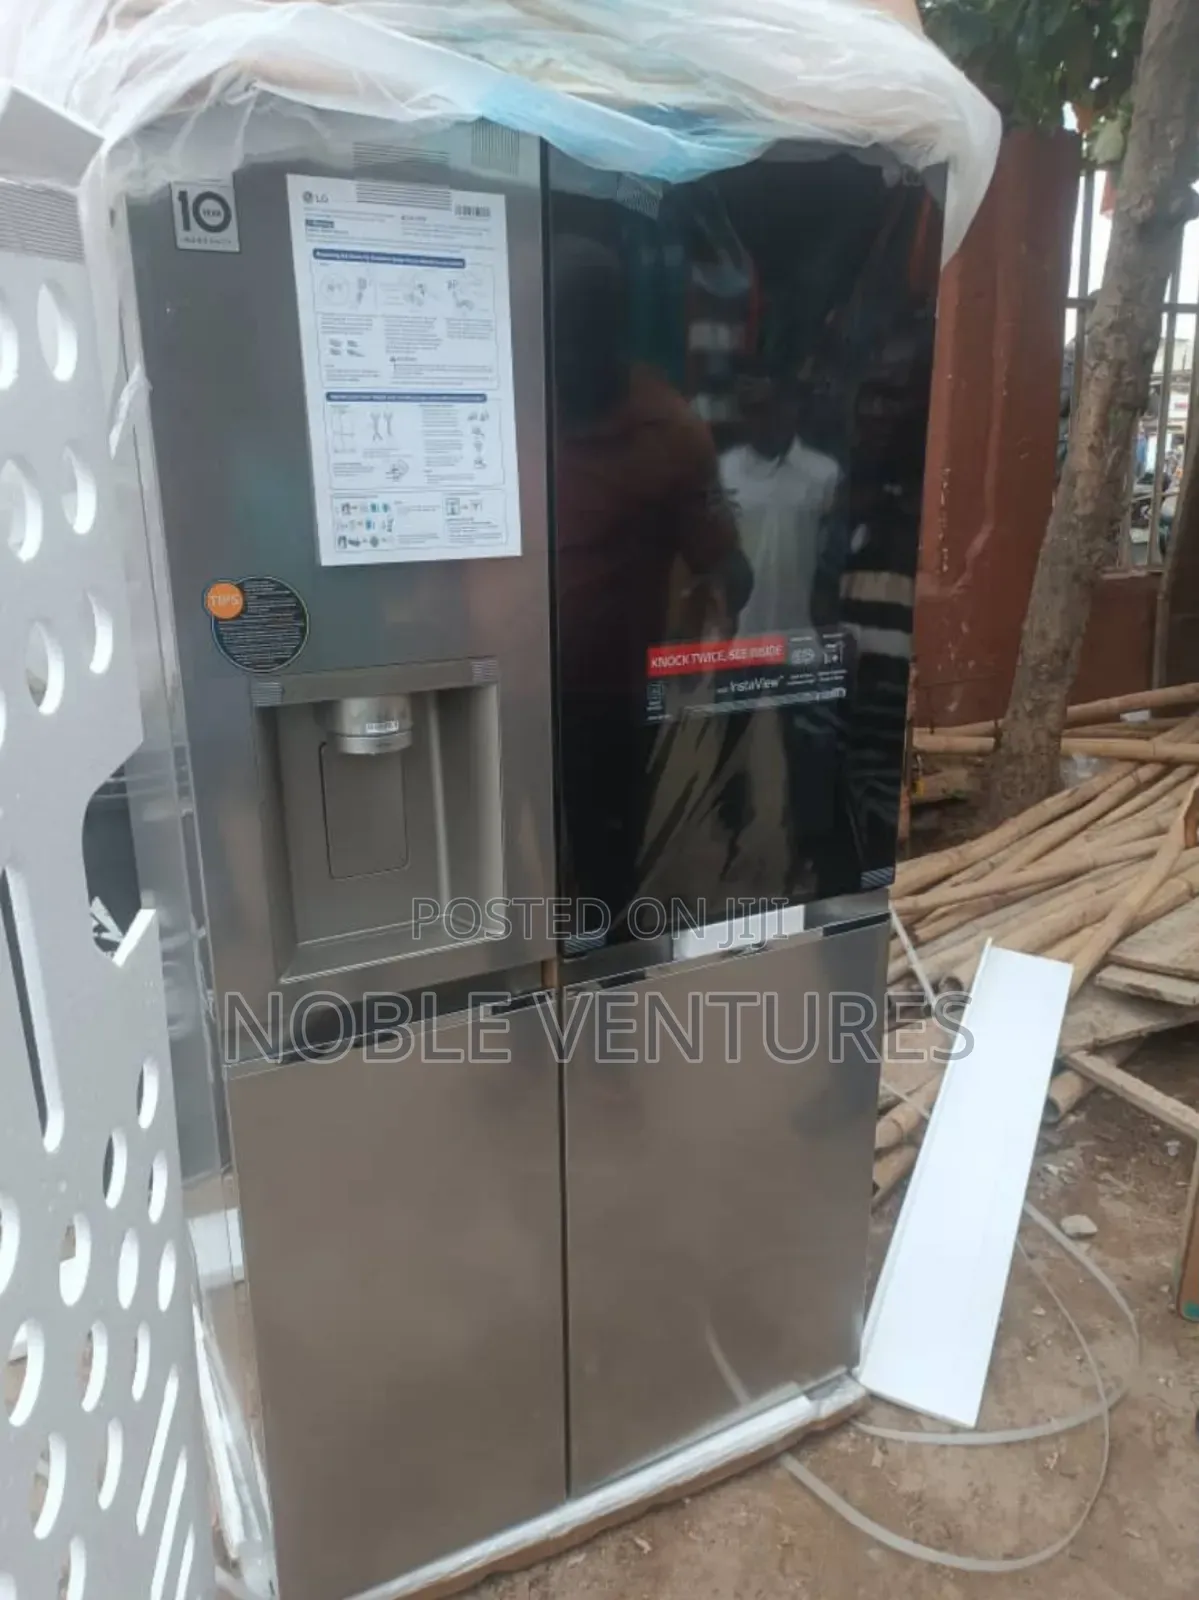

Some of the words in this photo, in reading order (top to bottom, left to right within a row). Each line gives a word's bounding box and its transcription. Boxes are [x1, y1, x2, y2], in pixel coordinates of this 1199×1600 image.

[315, 193, 329, 204] LG
[178, 190, 232, 233] 10
[651, 653, 689, 668] KNOCK
